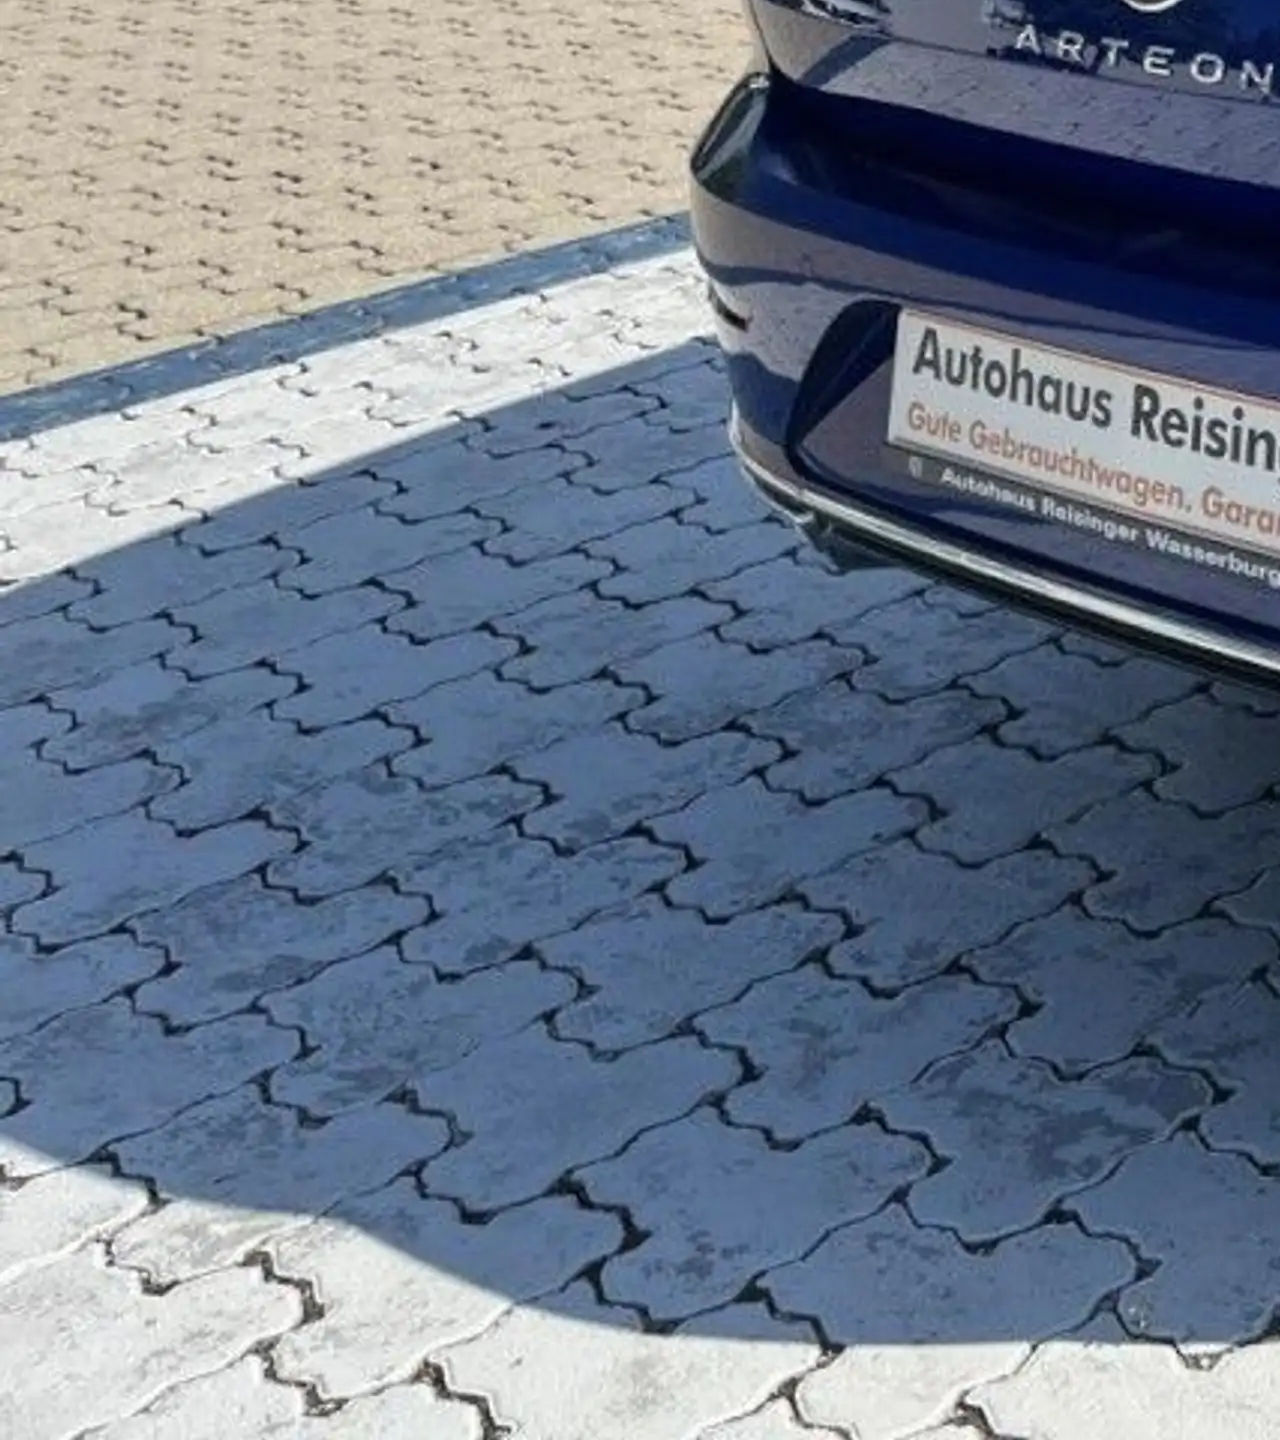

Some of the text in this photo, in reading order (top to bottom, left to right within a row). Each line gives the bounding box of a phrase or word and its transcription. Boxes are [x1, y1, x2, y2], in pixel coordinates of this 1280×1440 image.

[1014, 23, 1275, 96] ARTEON
[911, 326, 1115, 429] Autohaus
[907, 401, 962, 443] Gute
[968, 419, 1193, 512] Gebrauchtwagen.
[940, 466, 1037, 512] Autohaus
[1041, 497, 1139, 545] Reisinger
